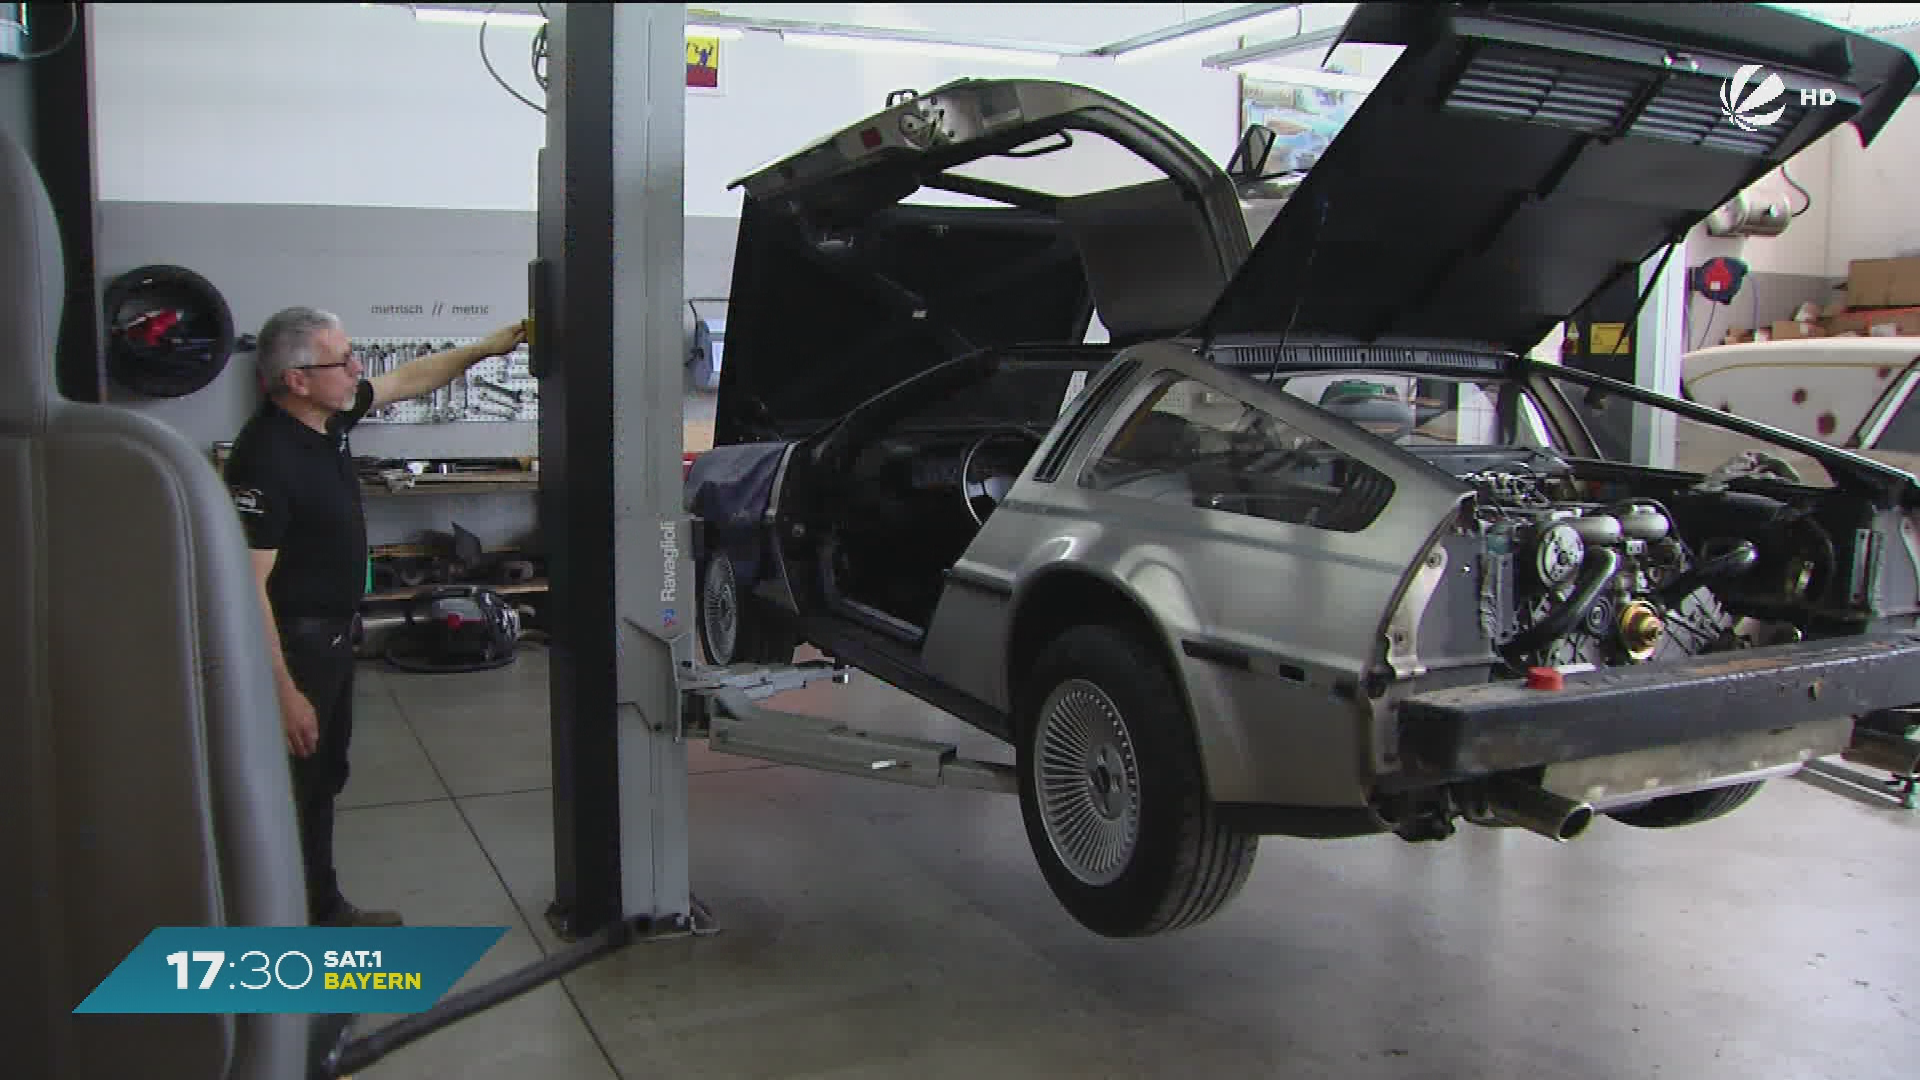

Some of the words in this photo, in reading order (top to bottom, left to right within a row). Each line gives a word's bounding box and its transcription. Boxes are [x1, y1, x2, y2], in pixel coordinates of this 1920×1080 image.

[370, 303, 423, 314] metrisch
[451, 304, 489, 314] metric
[660, 520, 679, 601] Ravaglioli
